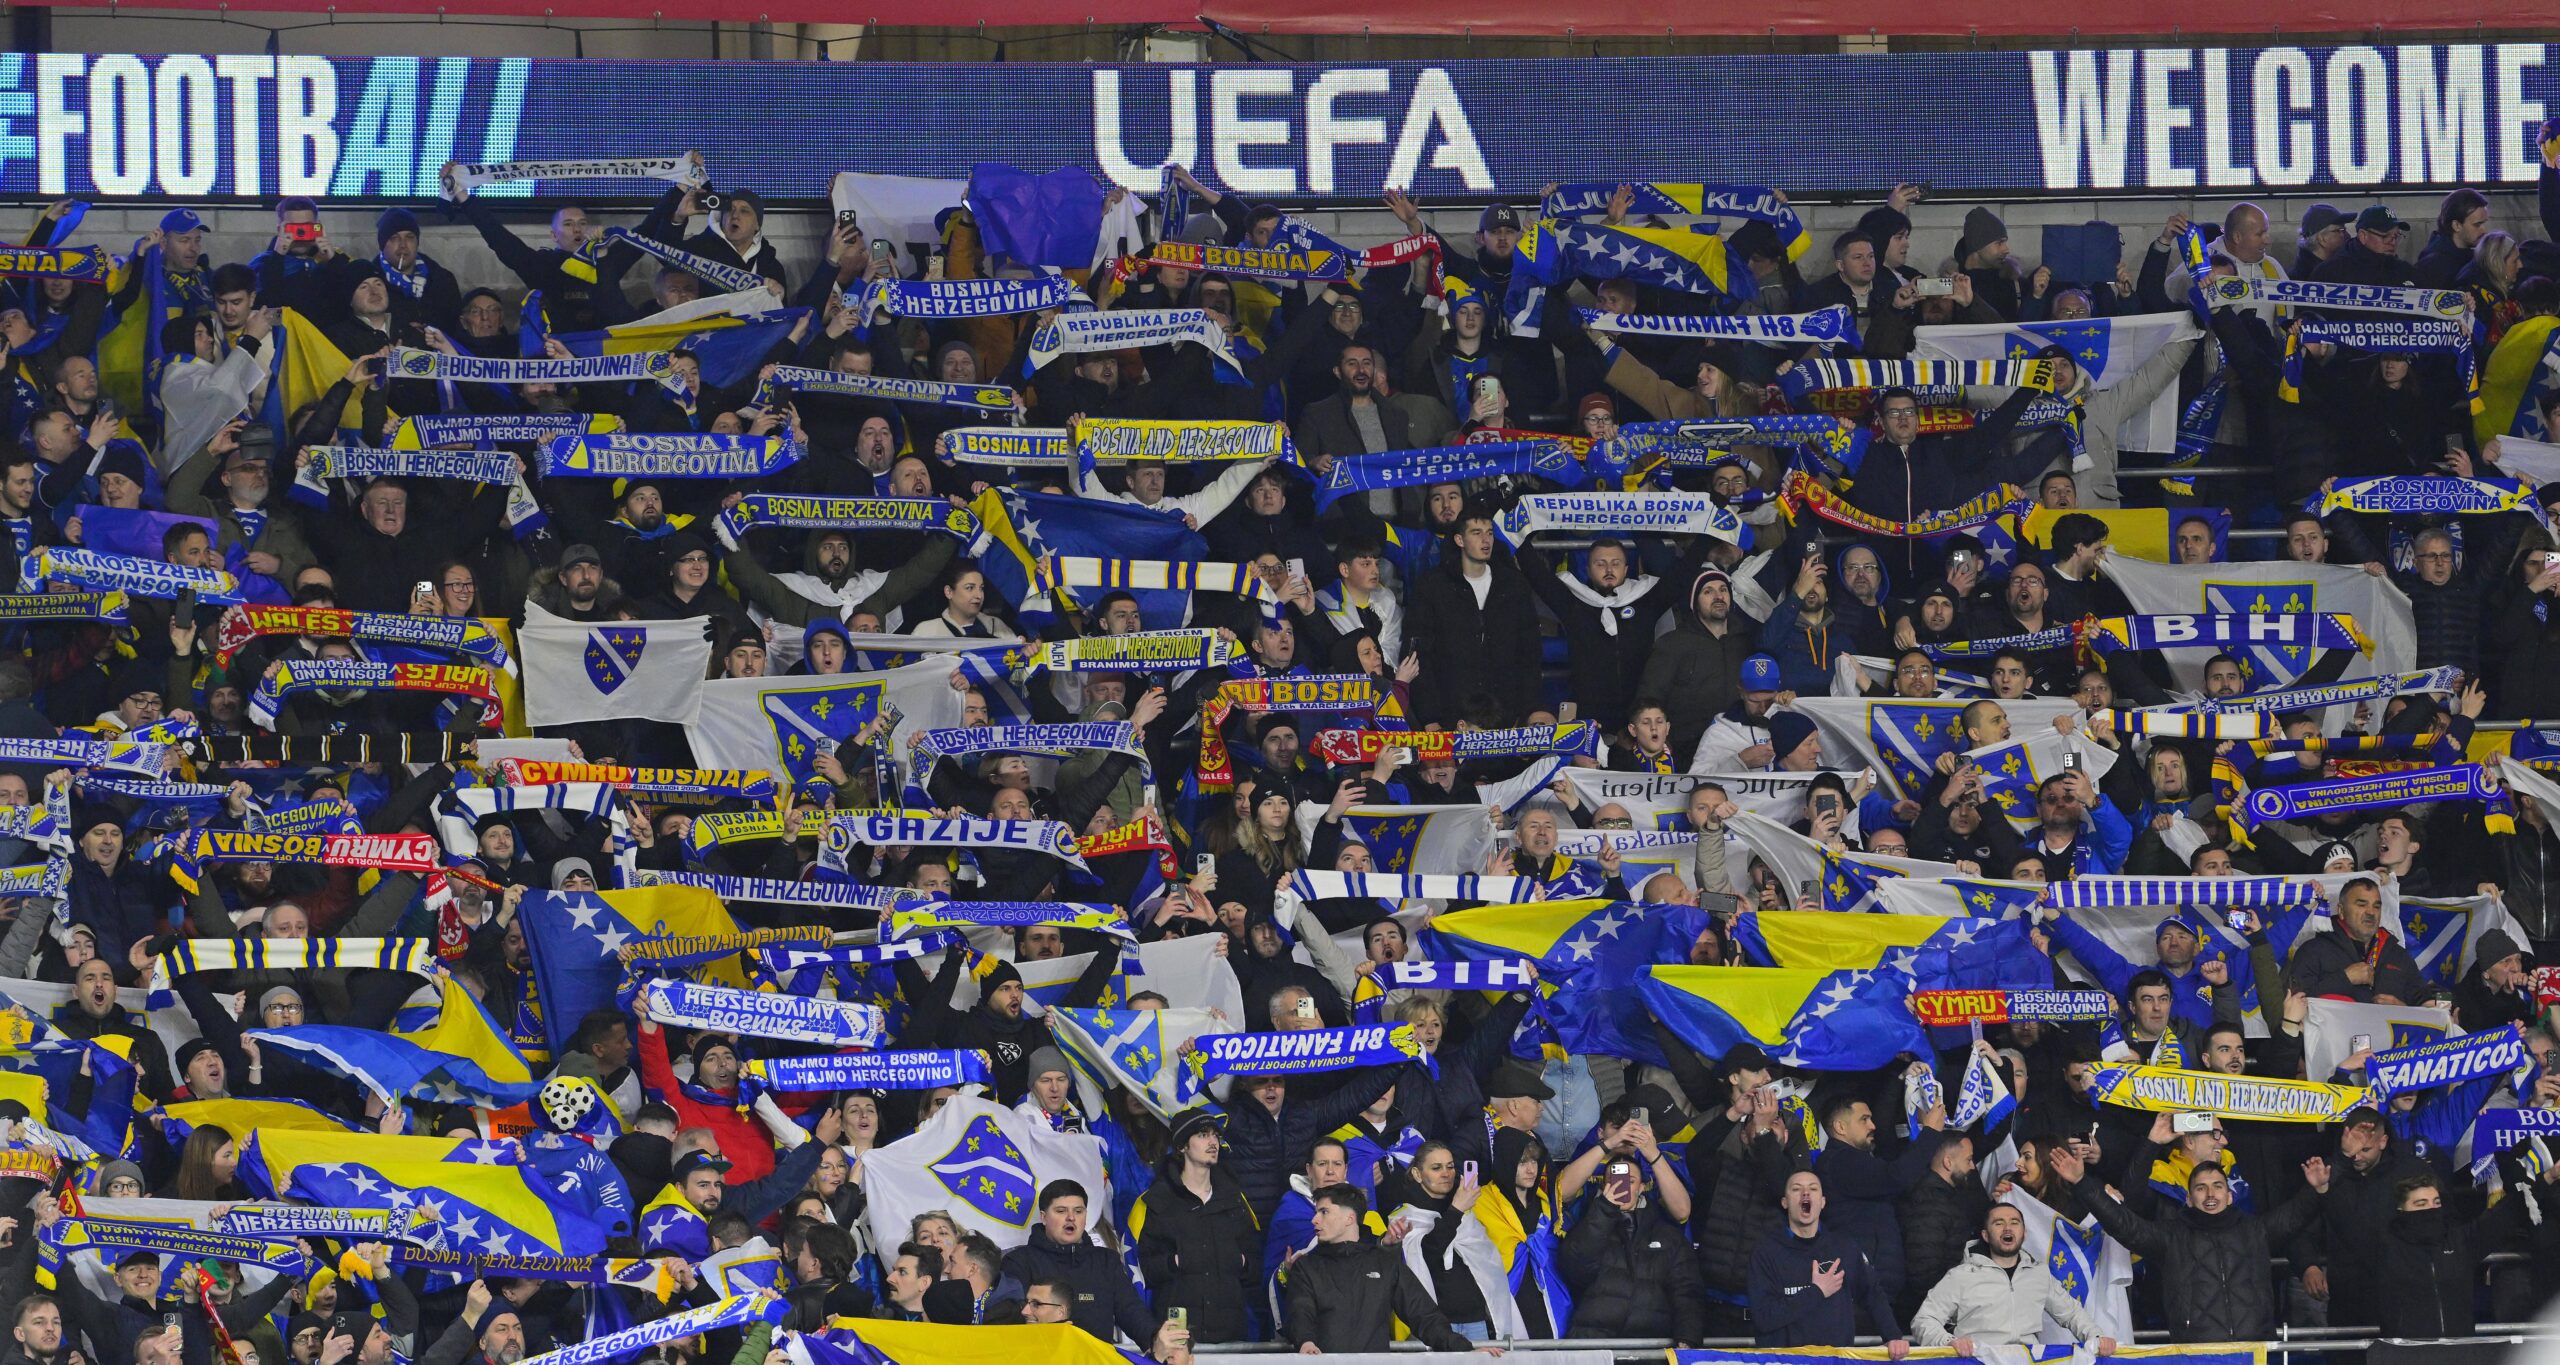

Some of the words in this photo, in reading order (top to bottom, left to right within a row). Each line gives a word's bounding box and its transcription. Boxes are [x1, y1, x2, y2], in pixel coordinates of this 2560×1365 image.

[2027, 43, 2546, 190] WELCOME
[1093, 66, 1496, 192] UEFA
[493, 169, 548, 180] BOSNIAN
[551, 167, 610, 178] SUPPORT
[613, 167, 648, 177] ARMY
[1206, 247, 1308, 272] BOSNIA
[1233, 266, 1261, 274] MARCH
[2276, 281, 2405, 300] GAZIJE
[905, 285, 1054, 317] HERZEGOVINA
[1068, 312, 1163, 333] REPUBLIKA
[2355, 322, 2410, 337] BOSNO,
[1093, 325, 1205, 344] HERCEGOVINA
[449, 357, 511, 378] BOSNIA
[515, 354, 632, 379] HERZEGOVINA
[838, 372, 957, 397] HERZEGOVINA
[426, 416, 471, 430] HAJMO
[609, 434, 723, 452] BOSNA
[726, 434, 743, 450] I
[968, 435, 1030, 455] BOSNIA
[1092, 425, 1141, 457] BOSNIA
[1142, 427, 1176, 457] AND
[1177, 425, 1277, 457] HERZEGOVINA
[406, 454, 506, 480] HERCEGOVINA
[590, 447, 760, 475] HERCEGOVINA
[1402, 452, 1477, 468] JEDNA
[768, 498, 822, 517] BOSNIA
[826, 499, 933, 521] HERZEGOVINA
[1533, 498, 1638, 513] REPUBLIKA
[1643, 498, 1706, 513] BOSNA
[1806, 482, 1895, 533] CYMRU
[2353, 495, 2502, 511] HERZEGOVINA
[1562, 513, 1689, 525] HERCEGOVINA
[51, 547, 217, 582] HERZEGOVINA
[19, 606, 87, 616] HERZEGOVINA
[376, 612, 444, 623] SEMI-FINAL
[250, 609, 340, 631] WALES
[361, 616, 422, 632] BOSNIA
[429, 622, 462, 634] AND
[360, 625, 460, 643] HERZEGOVINA
[1078, 637, 1115, 660] BOSNA
[1126, 636, 1201, 660] HERCEGOVINA
[406, 663, 489, 679] WALES
[1079, 661, 1141, 669] BRANIMO
[1143, 658, 1201, 668] ŽIVOTOM
[294, 668, 323, 681] AND
[327, 668, 386, 681] BOSNIA
[314, 680, 374, 690] SEMI-FINAL
[1299, 701, 1337, 710] MARCH
[1340, 700, 1372, 710] 2026
[1003, 723, 1117, 742] HERCEGOVINA
[1362, 734, 1443, 752] CYMRU
[1462, 730, 1520, 743] BOSNIA
[1524, 727, 1553, 739] AND
[1460, 736, 1550, 750] HERZEGOVINA
[1482, 747, 1513, 755] MARCH
[1517, 745, 1539, 753] 2026
[520, 761, 628, 783] CYMRU
[637, 768, 742, 788] BOSNIA
[2387, 777, 2409, 790] AND
[2411, 773, 2452, 788] BOSNIA
[2297, 783, 2402, 810] HERCEGOVINA
[2308, 781, 2383, 798] HERZEGOVINA
[711, 812, 767, 826] BOSNA
[728, 825, 769, 836] BOSNIA
[866, 817, 1029, 845] GAZIJE
[211, 832, 323, 857] BOSNIA
[329, 837, 433, 862] CYMRU
[273, 854, 293, 863] OFF
[296, 855, 322, 864] PLAY
[326, 857, 345, 866] CUP
[353, 858, 383, 867] WORLD
[677, 873, 743, 898] BOSNIA
[749, 880, 878, 906] HERZEGOVINA
[934, 908, 1076, 923] HERZEGOVINA
[1916, 995, 1997, 1016] CYMRU
[2014, 992, 2069, 1004] BOSNIA
[2073, 992, 2106, 1004] AND
[2013, 1002, 2107, 1015] HERZEGOVINA
[2038, 1013, 2069, 1021] MARCH
[2072, 1013, 2095, 1021] 2026
[1212, 1033, 1345, 1060] FANATICOS
[1350, 1028, 1384, 1052] BH
[2418, 1039, 2471, 1057] SUPPORT
[2473, 1029, 2509, 1047] ARMY
[780, 1056, 831, 1070] HAJMO
[833, 1054, 886, 1069] BOSNO,
[1228, 1062, 1258, 1072] ARMY
[1259, 1059, 1305, 1071] SUPPORT
[1306, 1056, 1356, 1069] BOSNIAN
[2382, 1041, 2523, 1093] FANATICOS
[851, 1065, 952, 1083] HERCEGOVINO
[2132, 1076, 2190, 1106] BOSNIA
[2193, 1083, 2225, 1110] AND
[2227, 1083, 2334, 1116] HERZEGOVINA
[262, 1207, 333, 1221] BOSNIA
[231, 1213, 386, 1234] HERZEGOVINA
[102, 1234, 142, 1246] BOSNIA
[148, 1238, 172, 1249] AND
[173, 1241, 249, 1258] HERZEGOVINA
[403, 1246, 462, 1265] BOSNA
